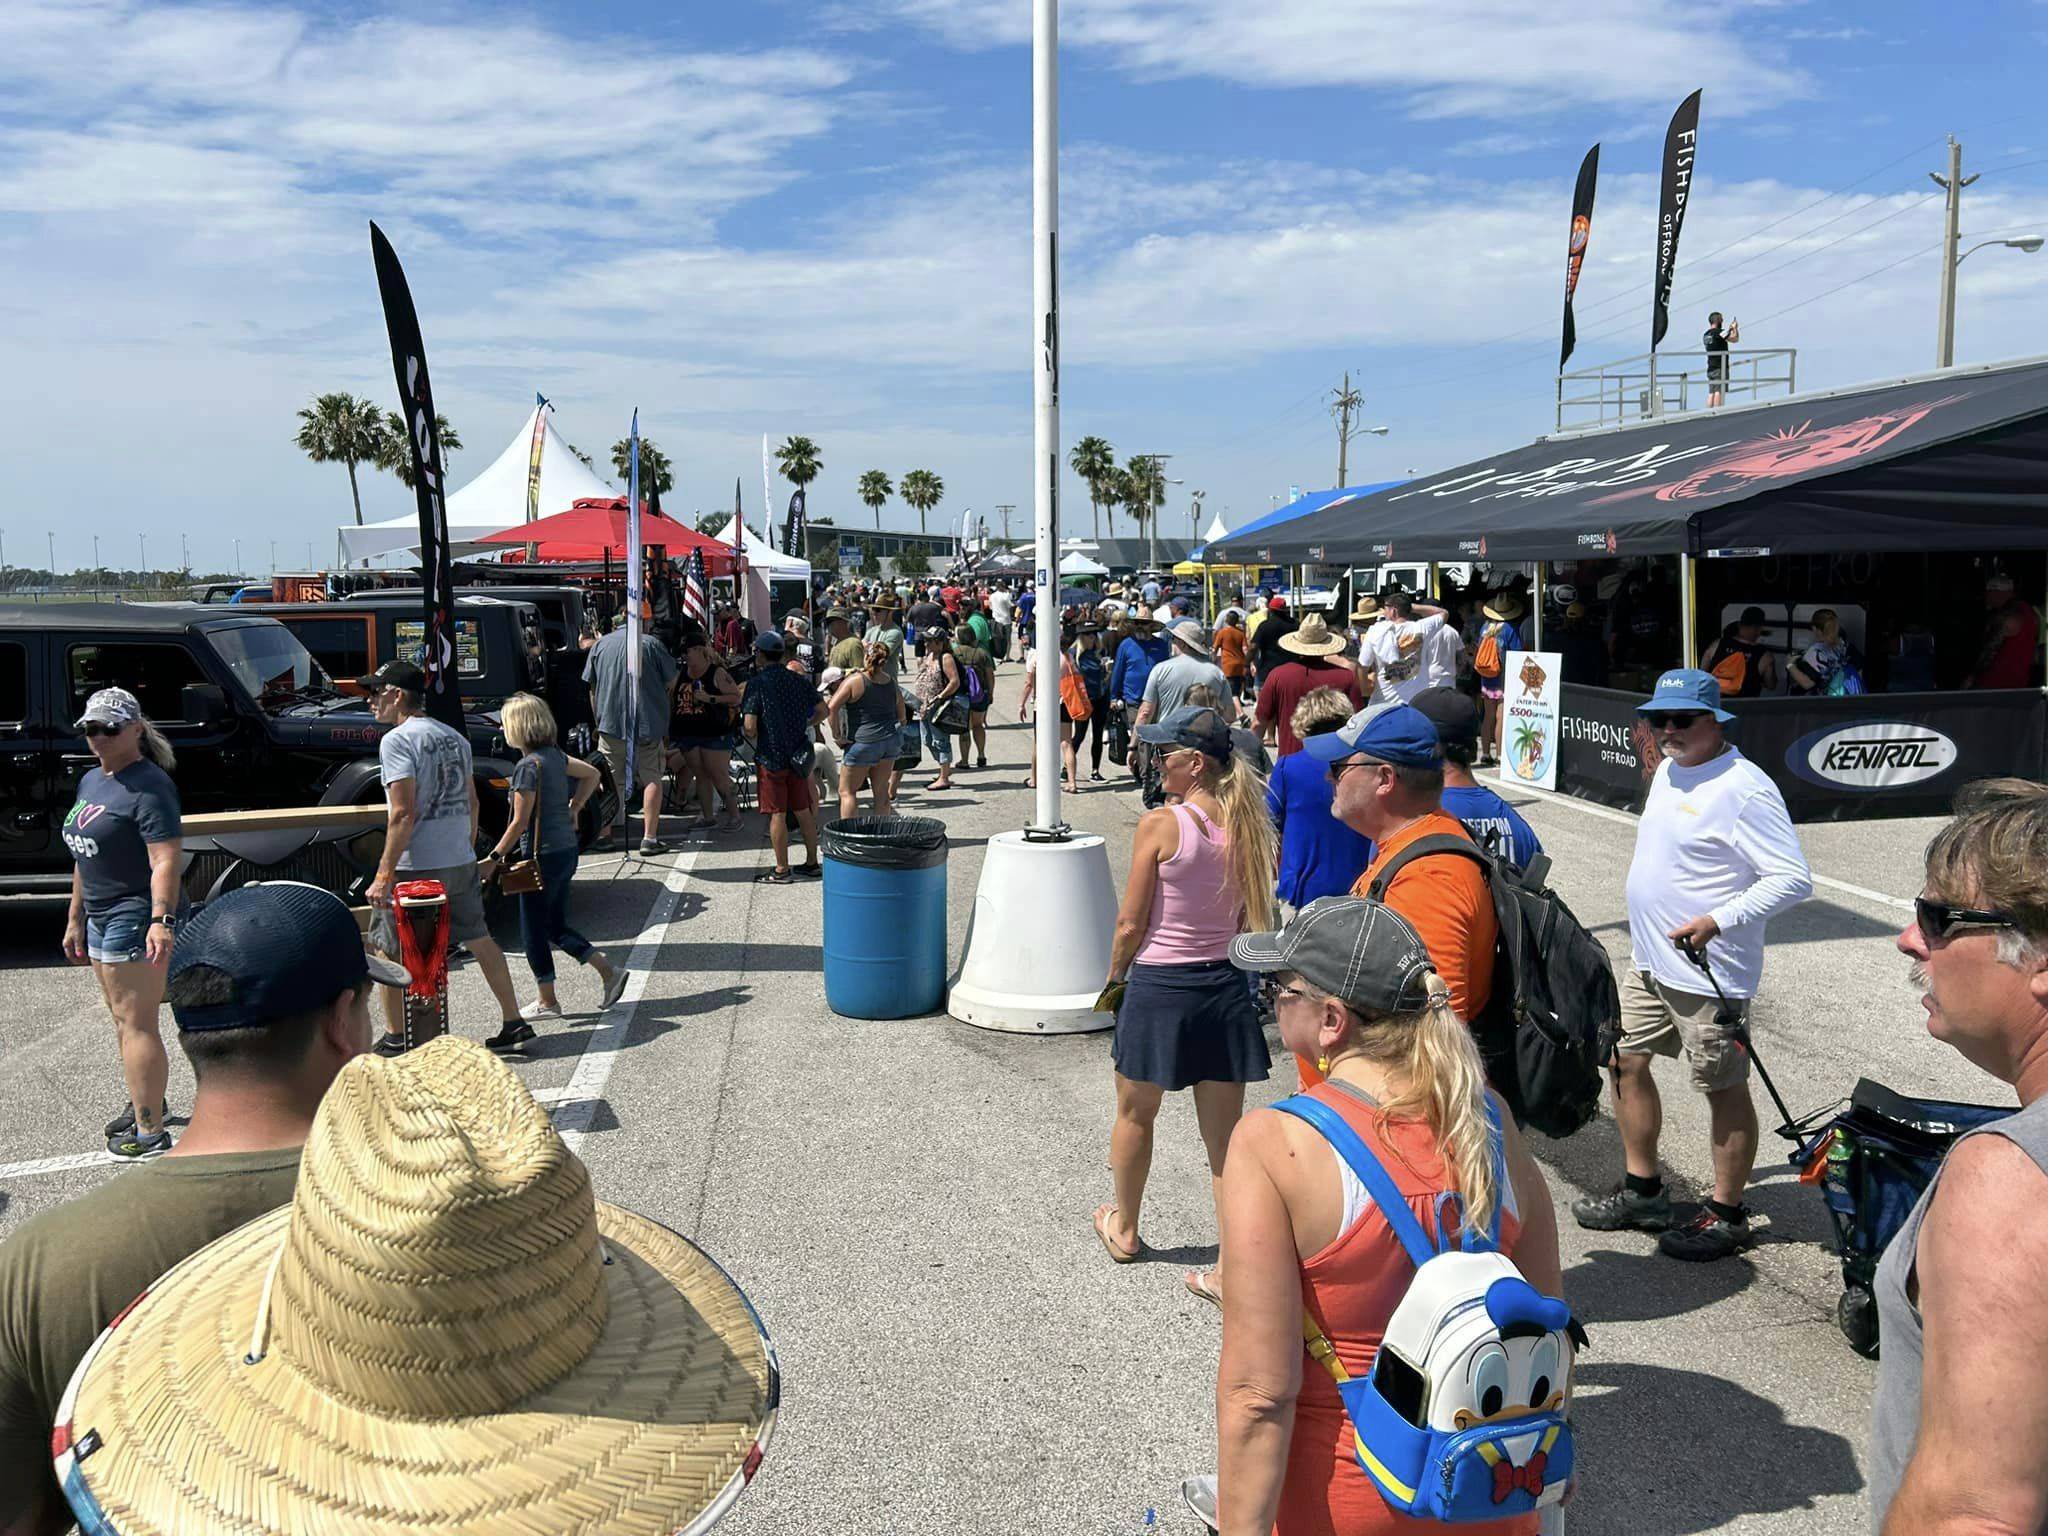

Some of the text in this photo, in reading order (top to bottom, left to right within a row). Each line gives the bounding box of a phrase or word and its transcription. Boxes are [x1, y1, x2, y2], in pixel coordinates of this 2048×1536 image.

[1561, 716, 1631, 750] FISHBONE
[1601, 750, 1637, 768] OFFROAD
[1821, 737, 1940, 771] KENTROL
